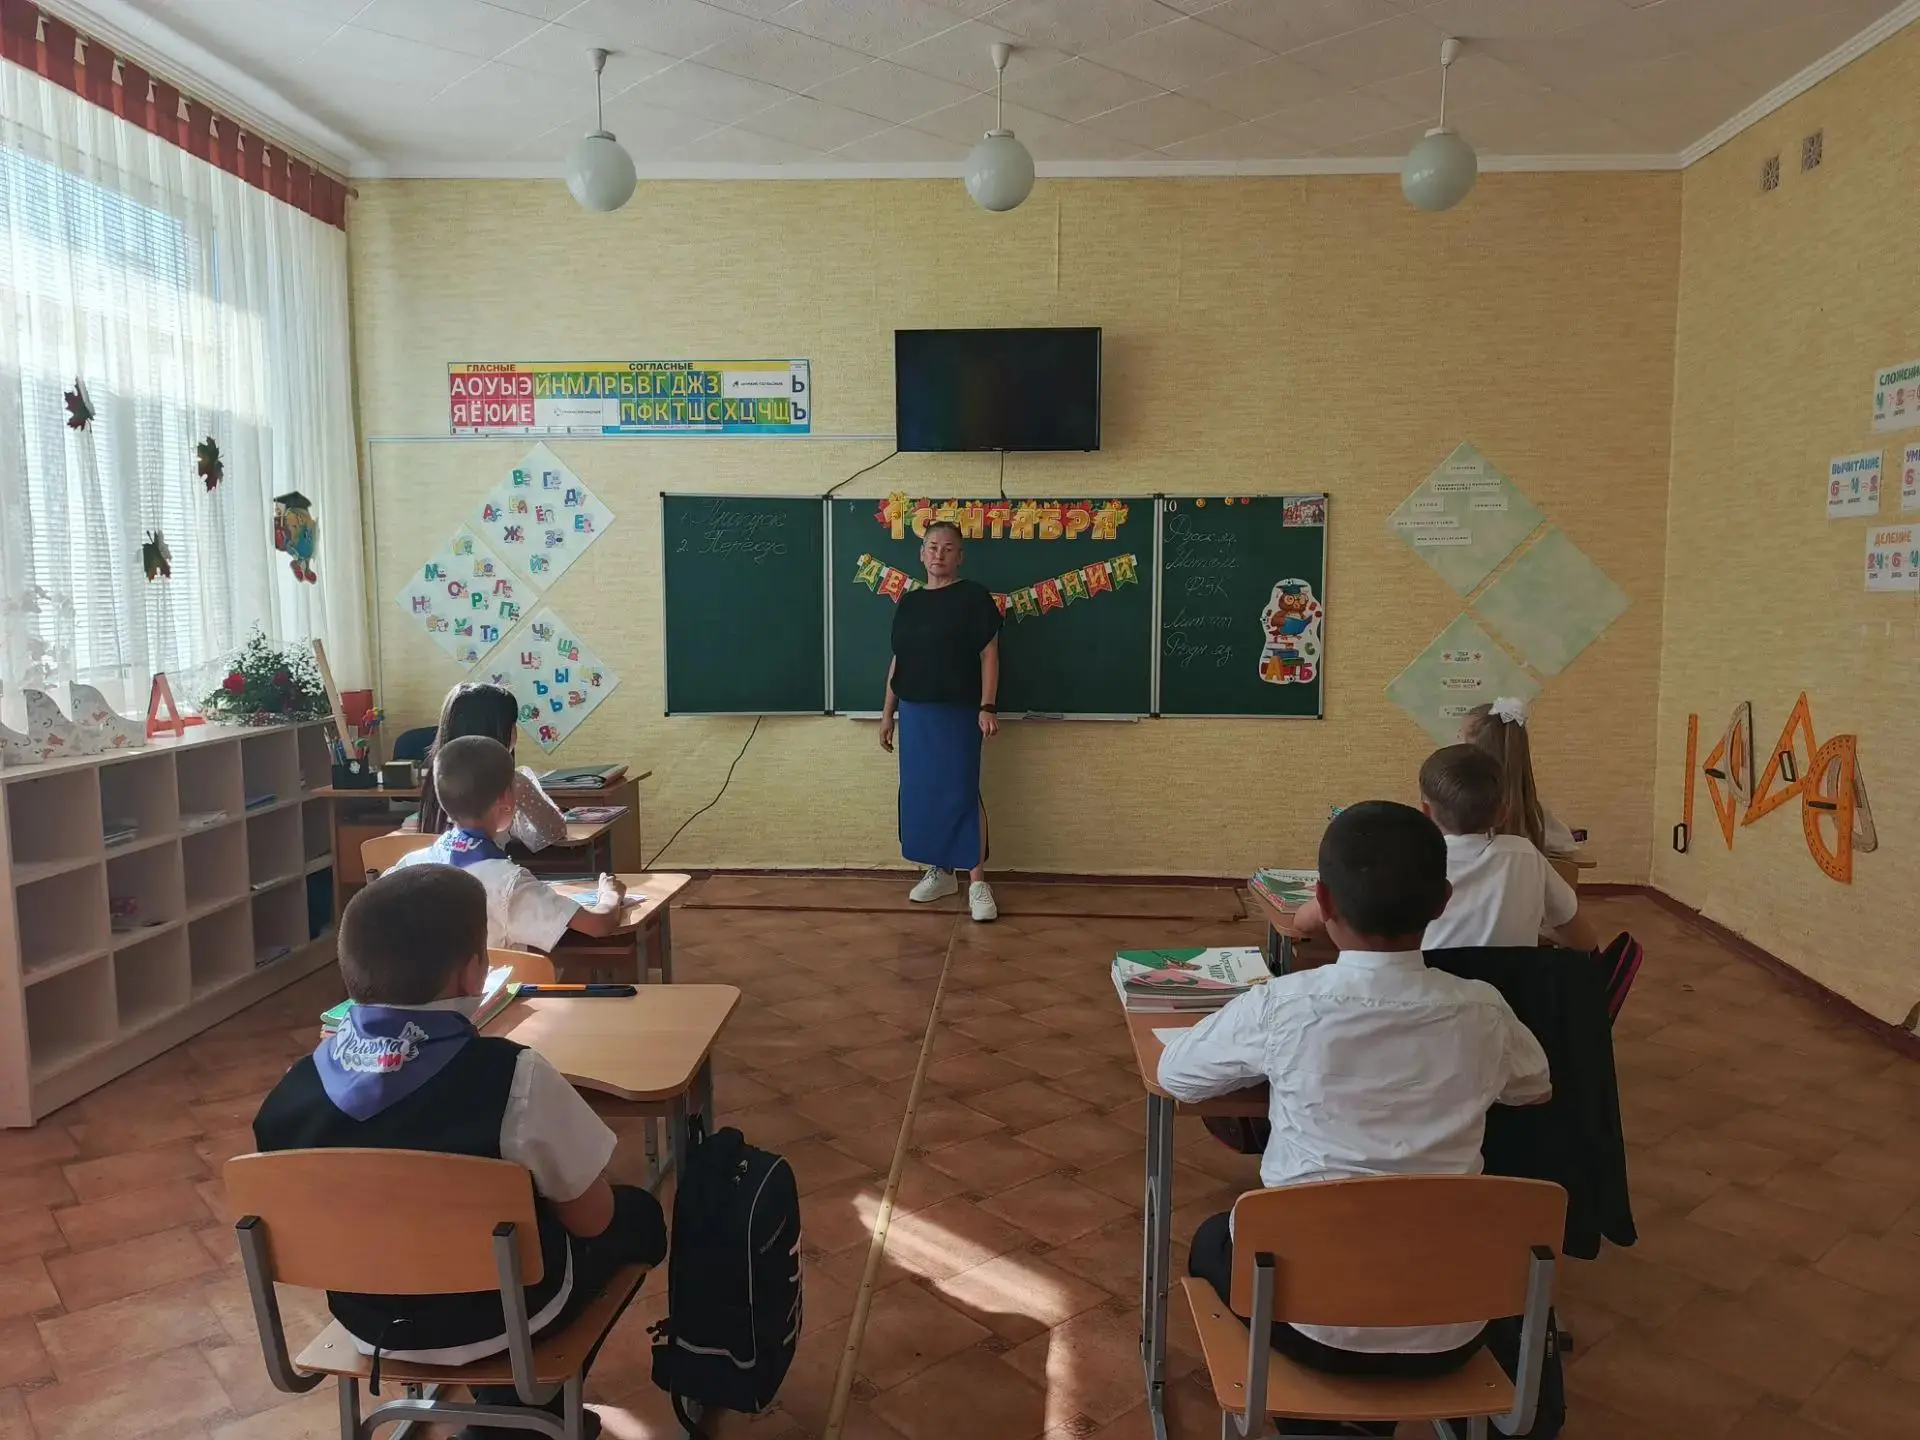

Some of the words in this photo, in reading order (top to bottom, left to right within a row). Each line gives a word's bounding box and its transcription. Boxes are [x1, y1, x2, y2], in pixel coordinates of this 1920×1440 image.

[466, 362, 517, 373] ГЛАСНЫЕ
[628, 361, 695, 372] СОГЛАСНЫЕ
[1879, 365, 1920, 387] СЛОЖЕНИ
[1831, 456, 1880, 476] ВЫЧИТАНИЕ
[1874, 530, 1912, 547] ДЕЛЕНИЕ
